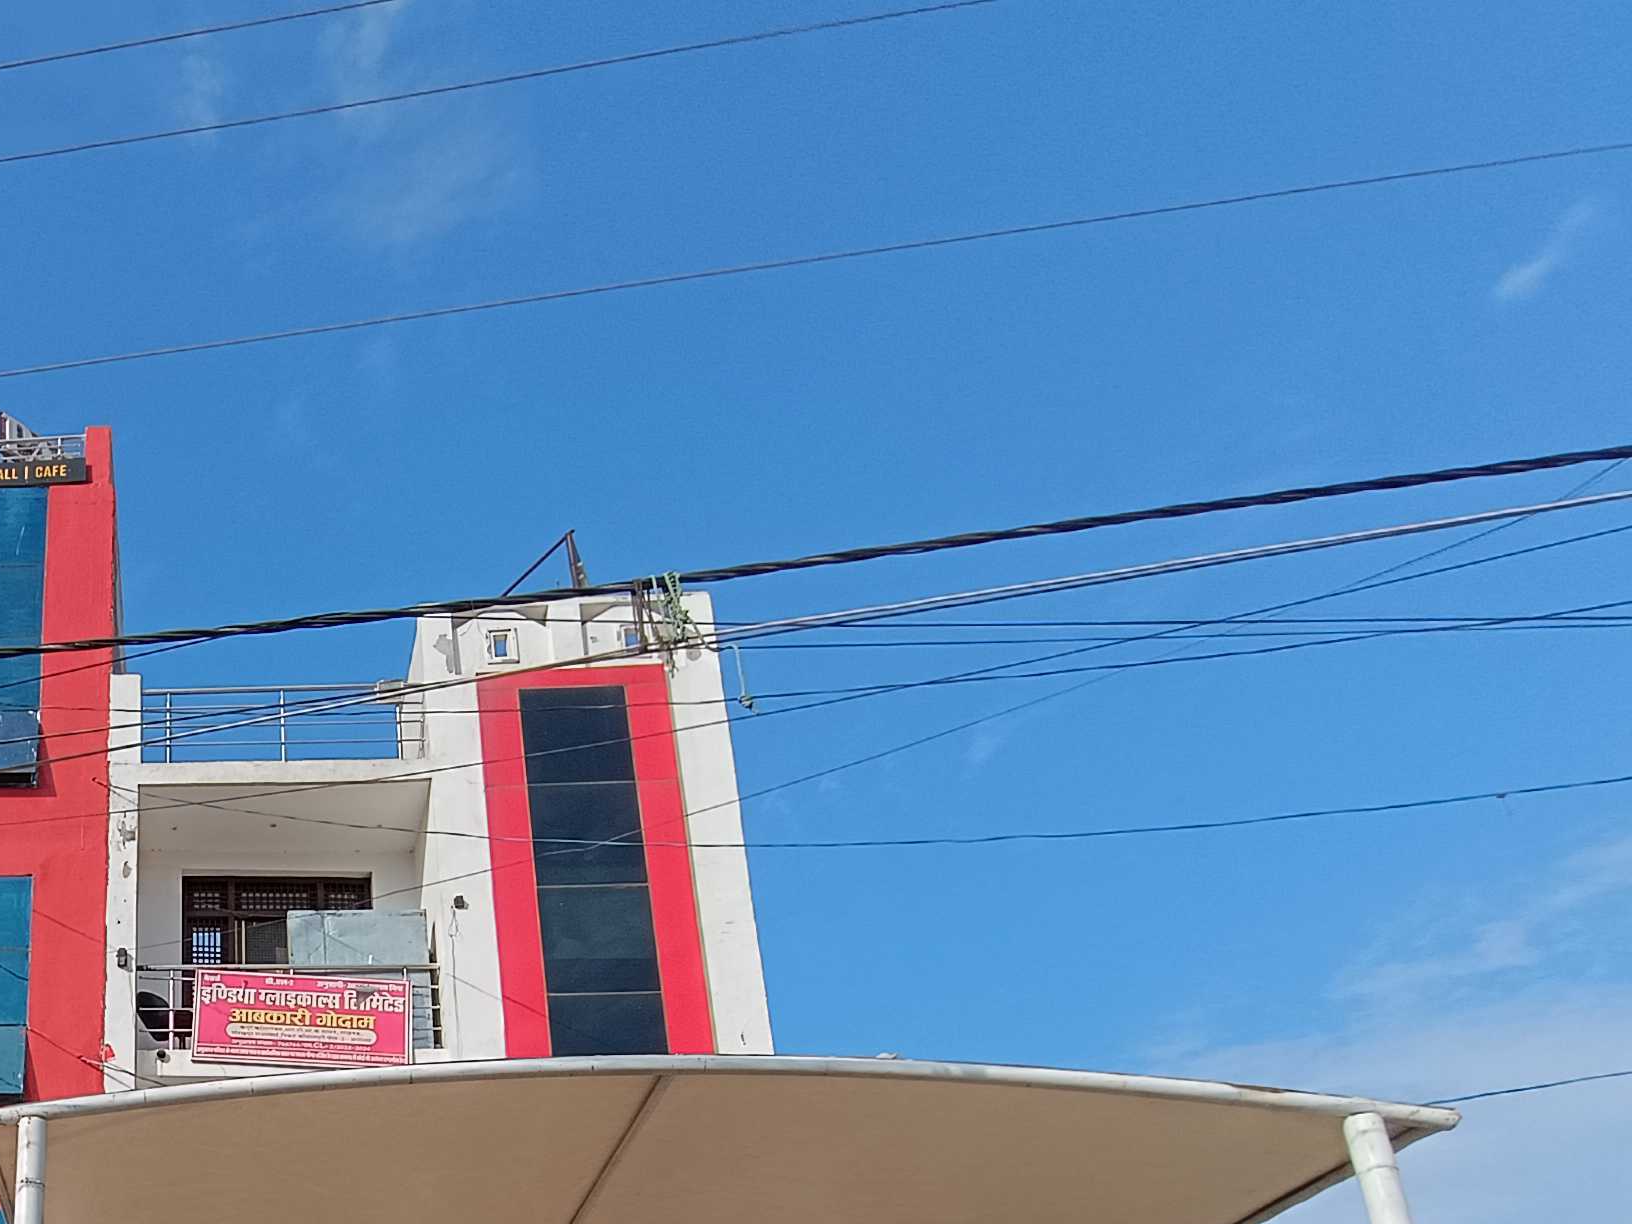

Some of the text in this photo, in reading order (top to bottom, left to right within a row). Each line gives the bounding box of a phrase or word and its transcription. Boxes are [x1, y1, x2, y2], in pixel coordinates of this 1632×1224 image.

[35, 464, 68, 478] CAFE
[228, 1007, 377, 1030] आबकारी गोदाम
